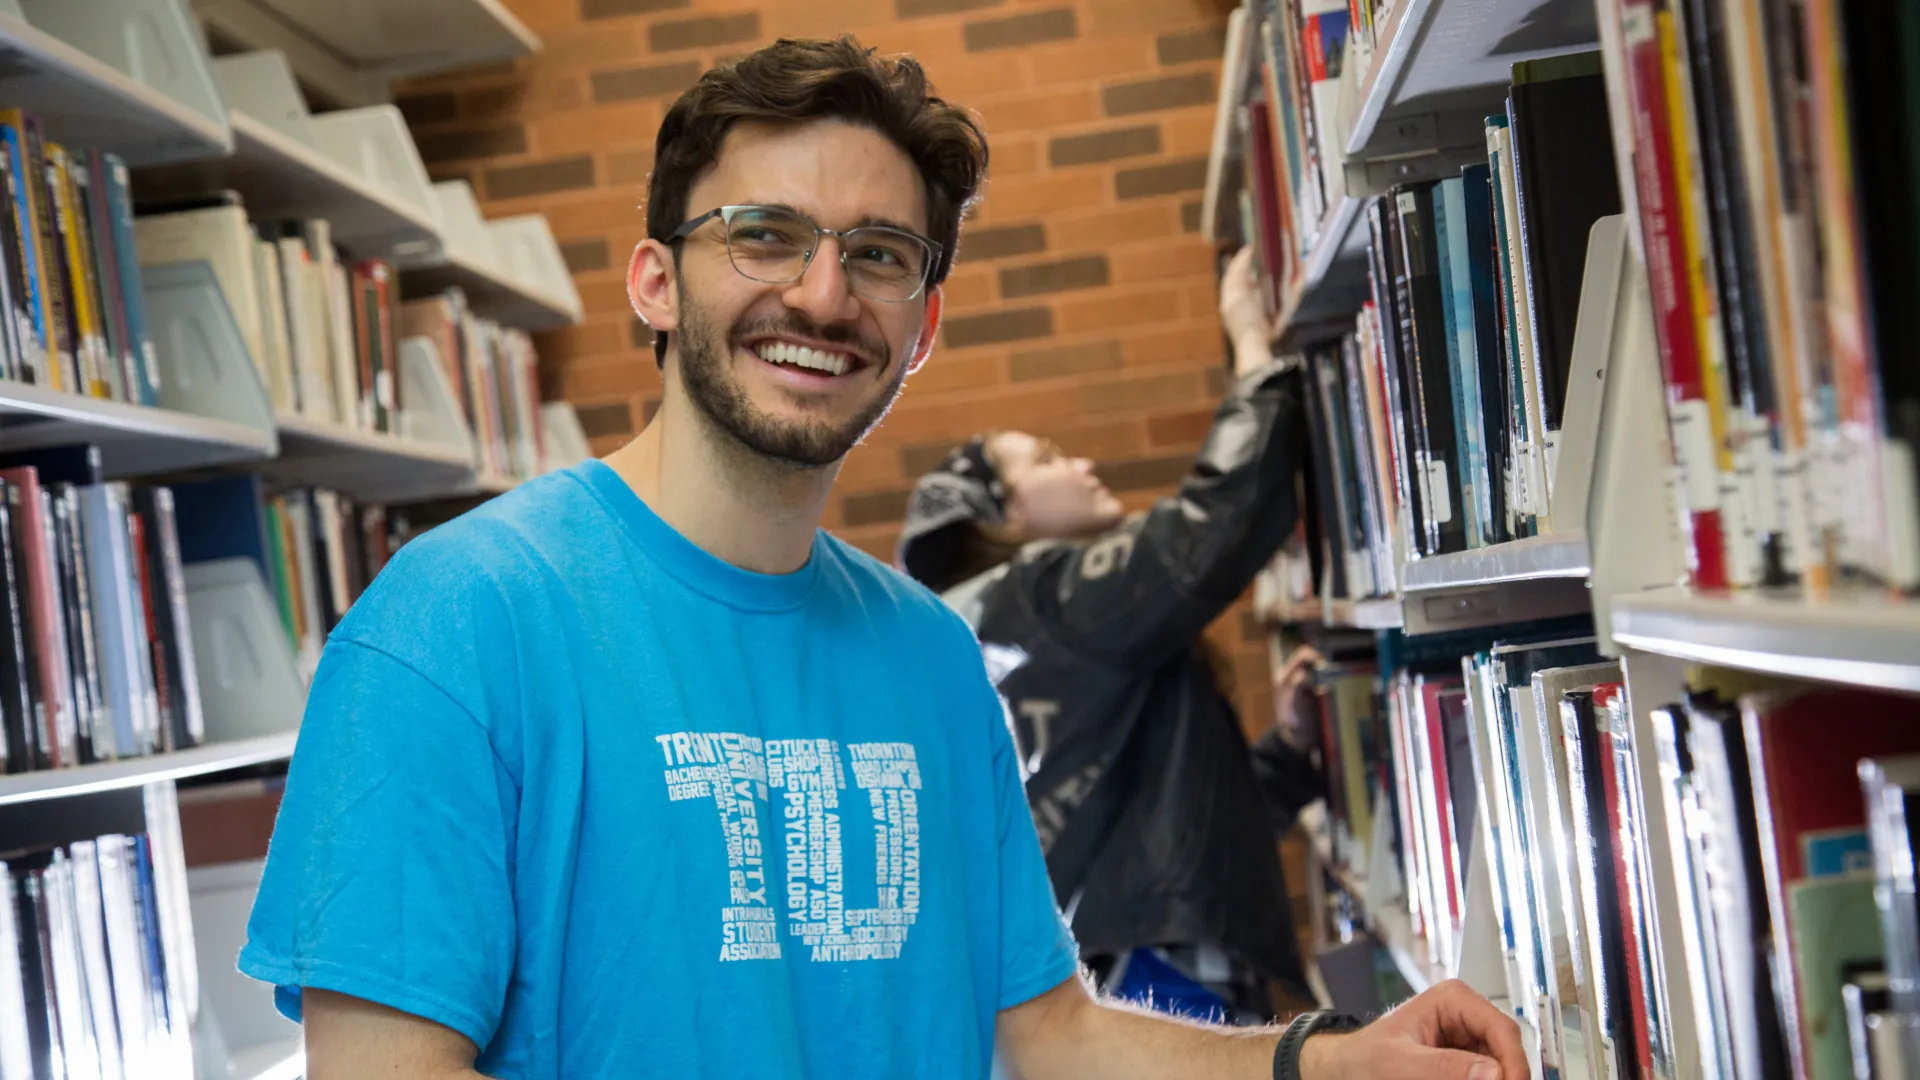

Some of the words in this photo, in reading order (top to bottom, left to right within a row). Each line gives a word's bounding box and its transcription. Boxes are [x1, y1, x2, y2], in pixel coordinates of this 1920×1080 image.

[765, 740, 785, 788] CLUBS
[781, 739, 817, 757] TUCK
[783, 755, 820, 773] SHOP
[816, 738, 839, 809] BUSINESS
[717, 763, 739, 816] SOCIAL
[787, 772, 820, 793] GYM
[868, 788, 887, 821] NEW
[719, 732, 767, 906] UNIVERSITY
[807, 791, 825, 885] MEMBERSHIP
[885, 789, 903, 886] PROFESSORS
[783, 792, 807, 923] PSYCHOLOGY
[824, 812, 844, 935] ADMINISTRATION
[874, 824, 889, 886] FRIENDS
[900, 789, 921, 914] ORIENTATION
[722, 921, 777, 944] STUDENT
[811, 941, 903, 963] ANTHROPOLOGY
